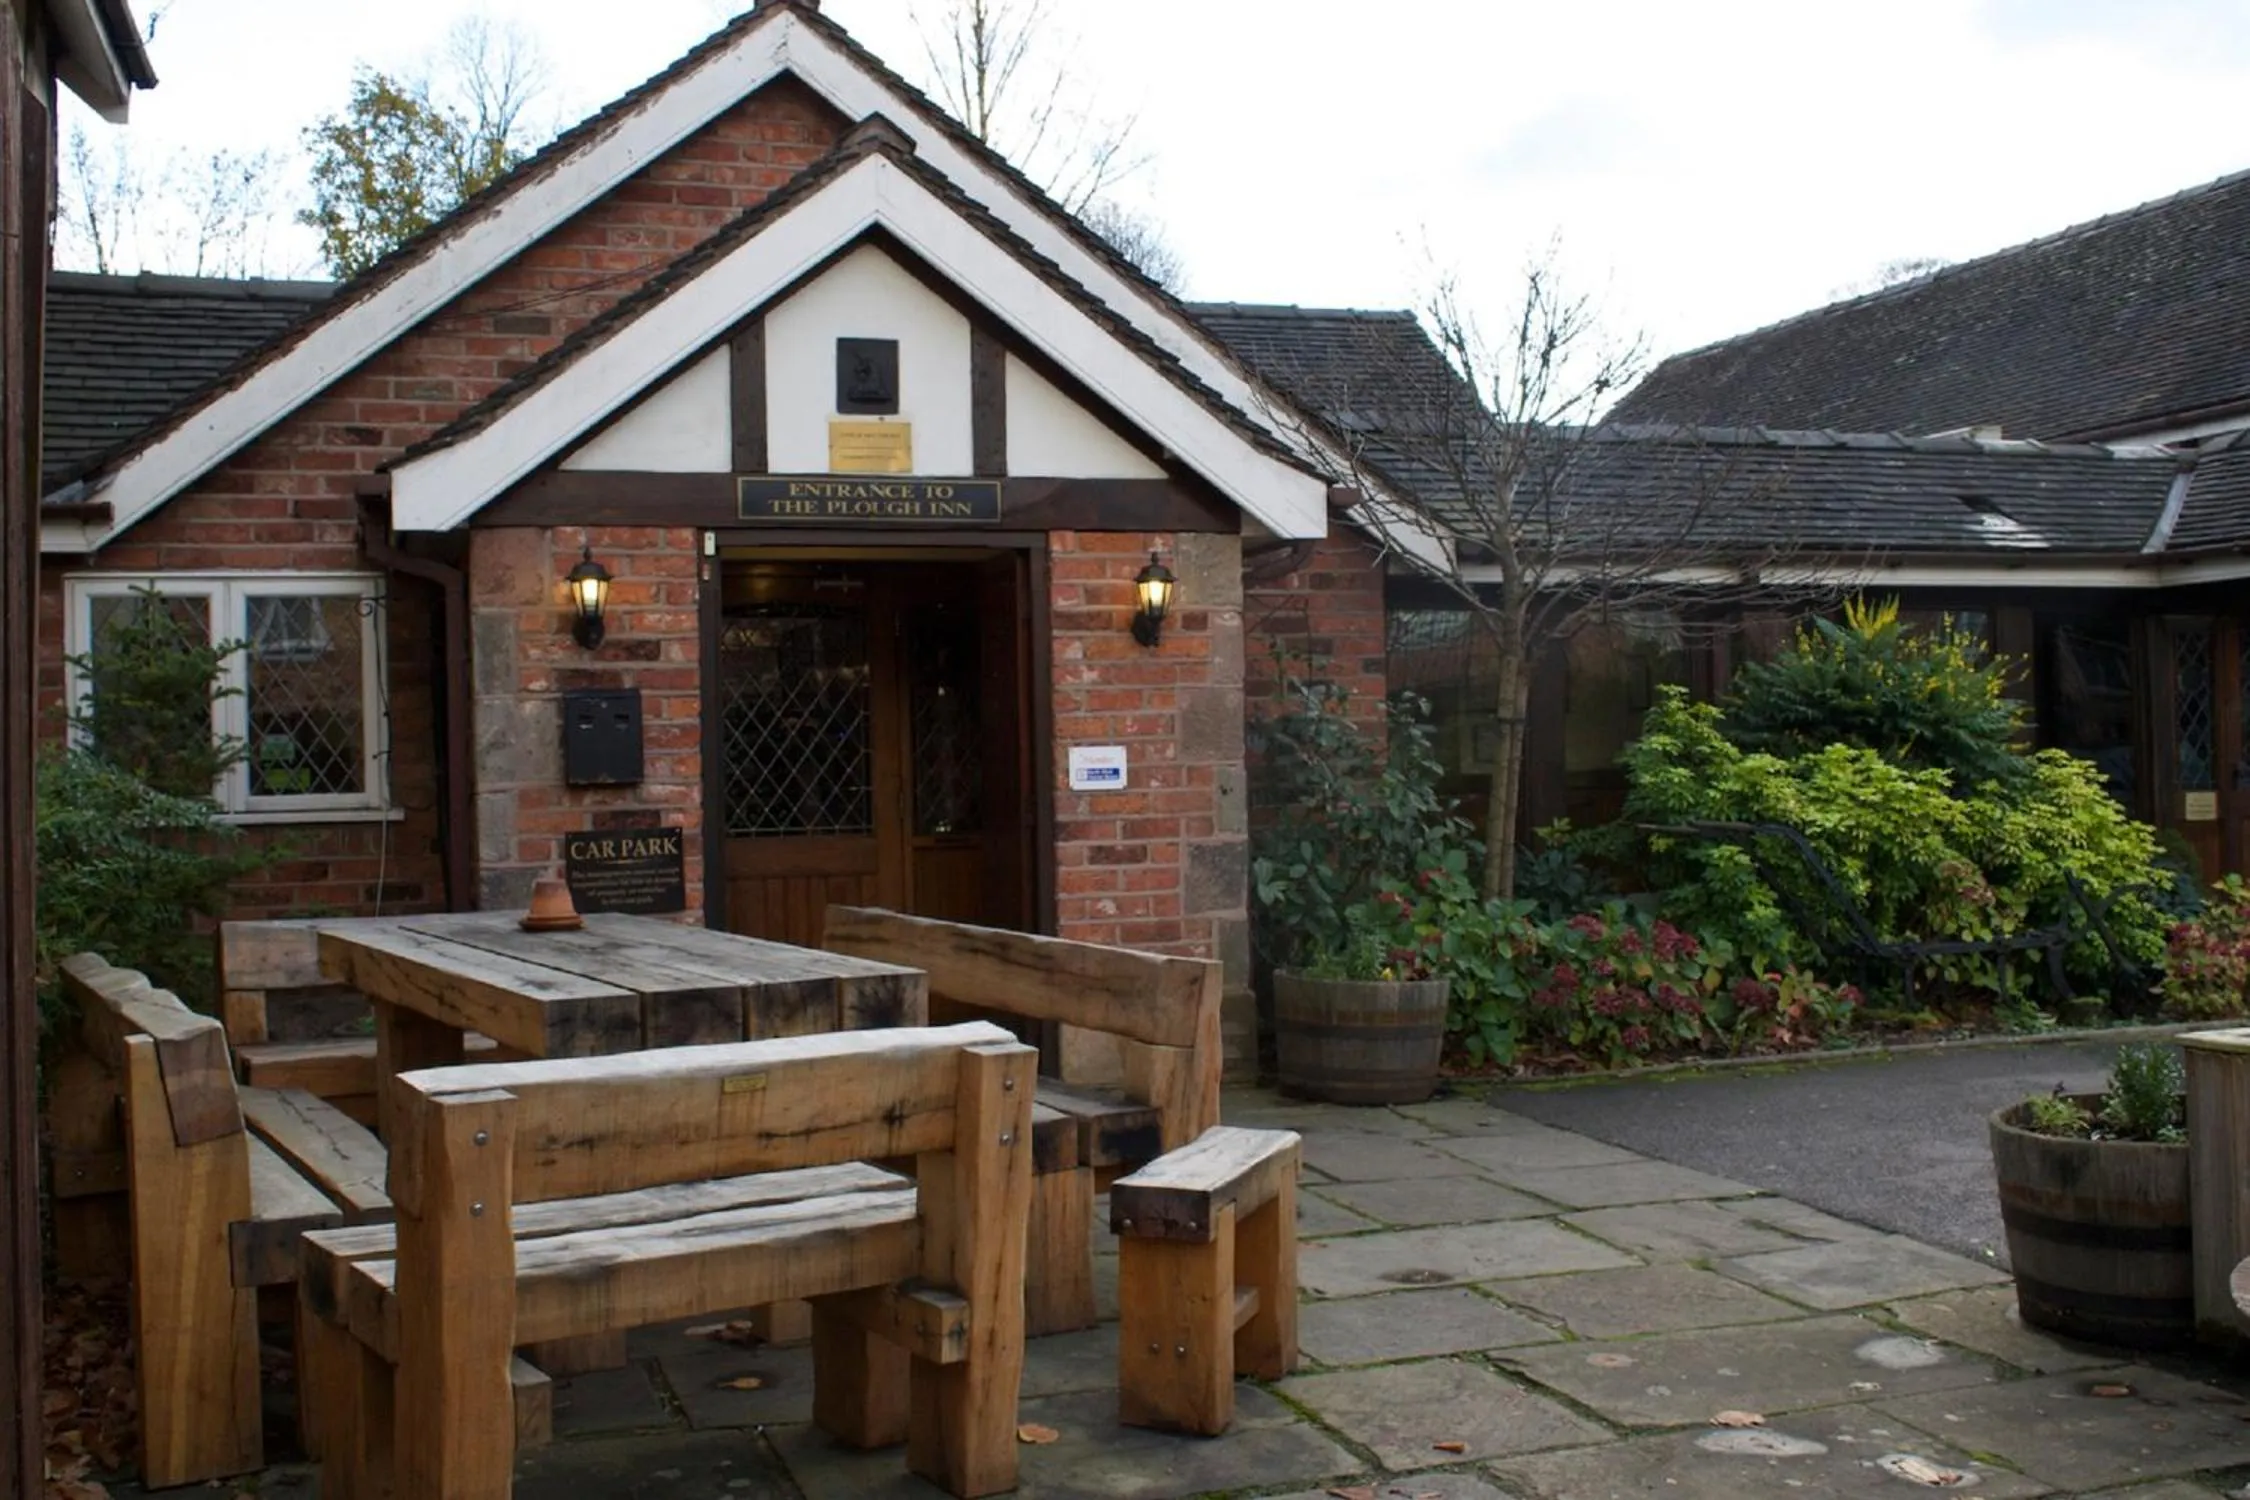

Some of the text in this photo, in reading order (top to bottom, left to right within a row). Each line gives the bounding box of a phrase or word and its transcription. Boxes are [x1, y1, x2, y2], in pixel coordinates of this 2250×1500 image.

[789, 482, 954, 500] ENTRANCE TO
[769, 499, 973, 516] THE PLOUGH INN
[570, 837, 679, 860] CAR PARK
